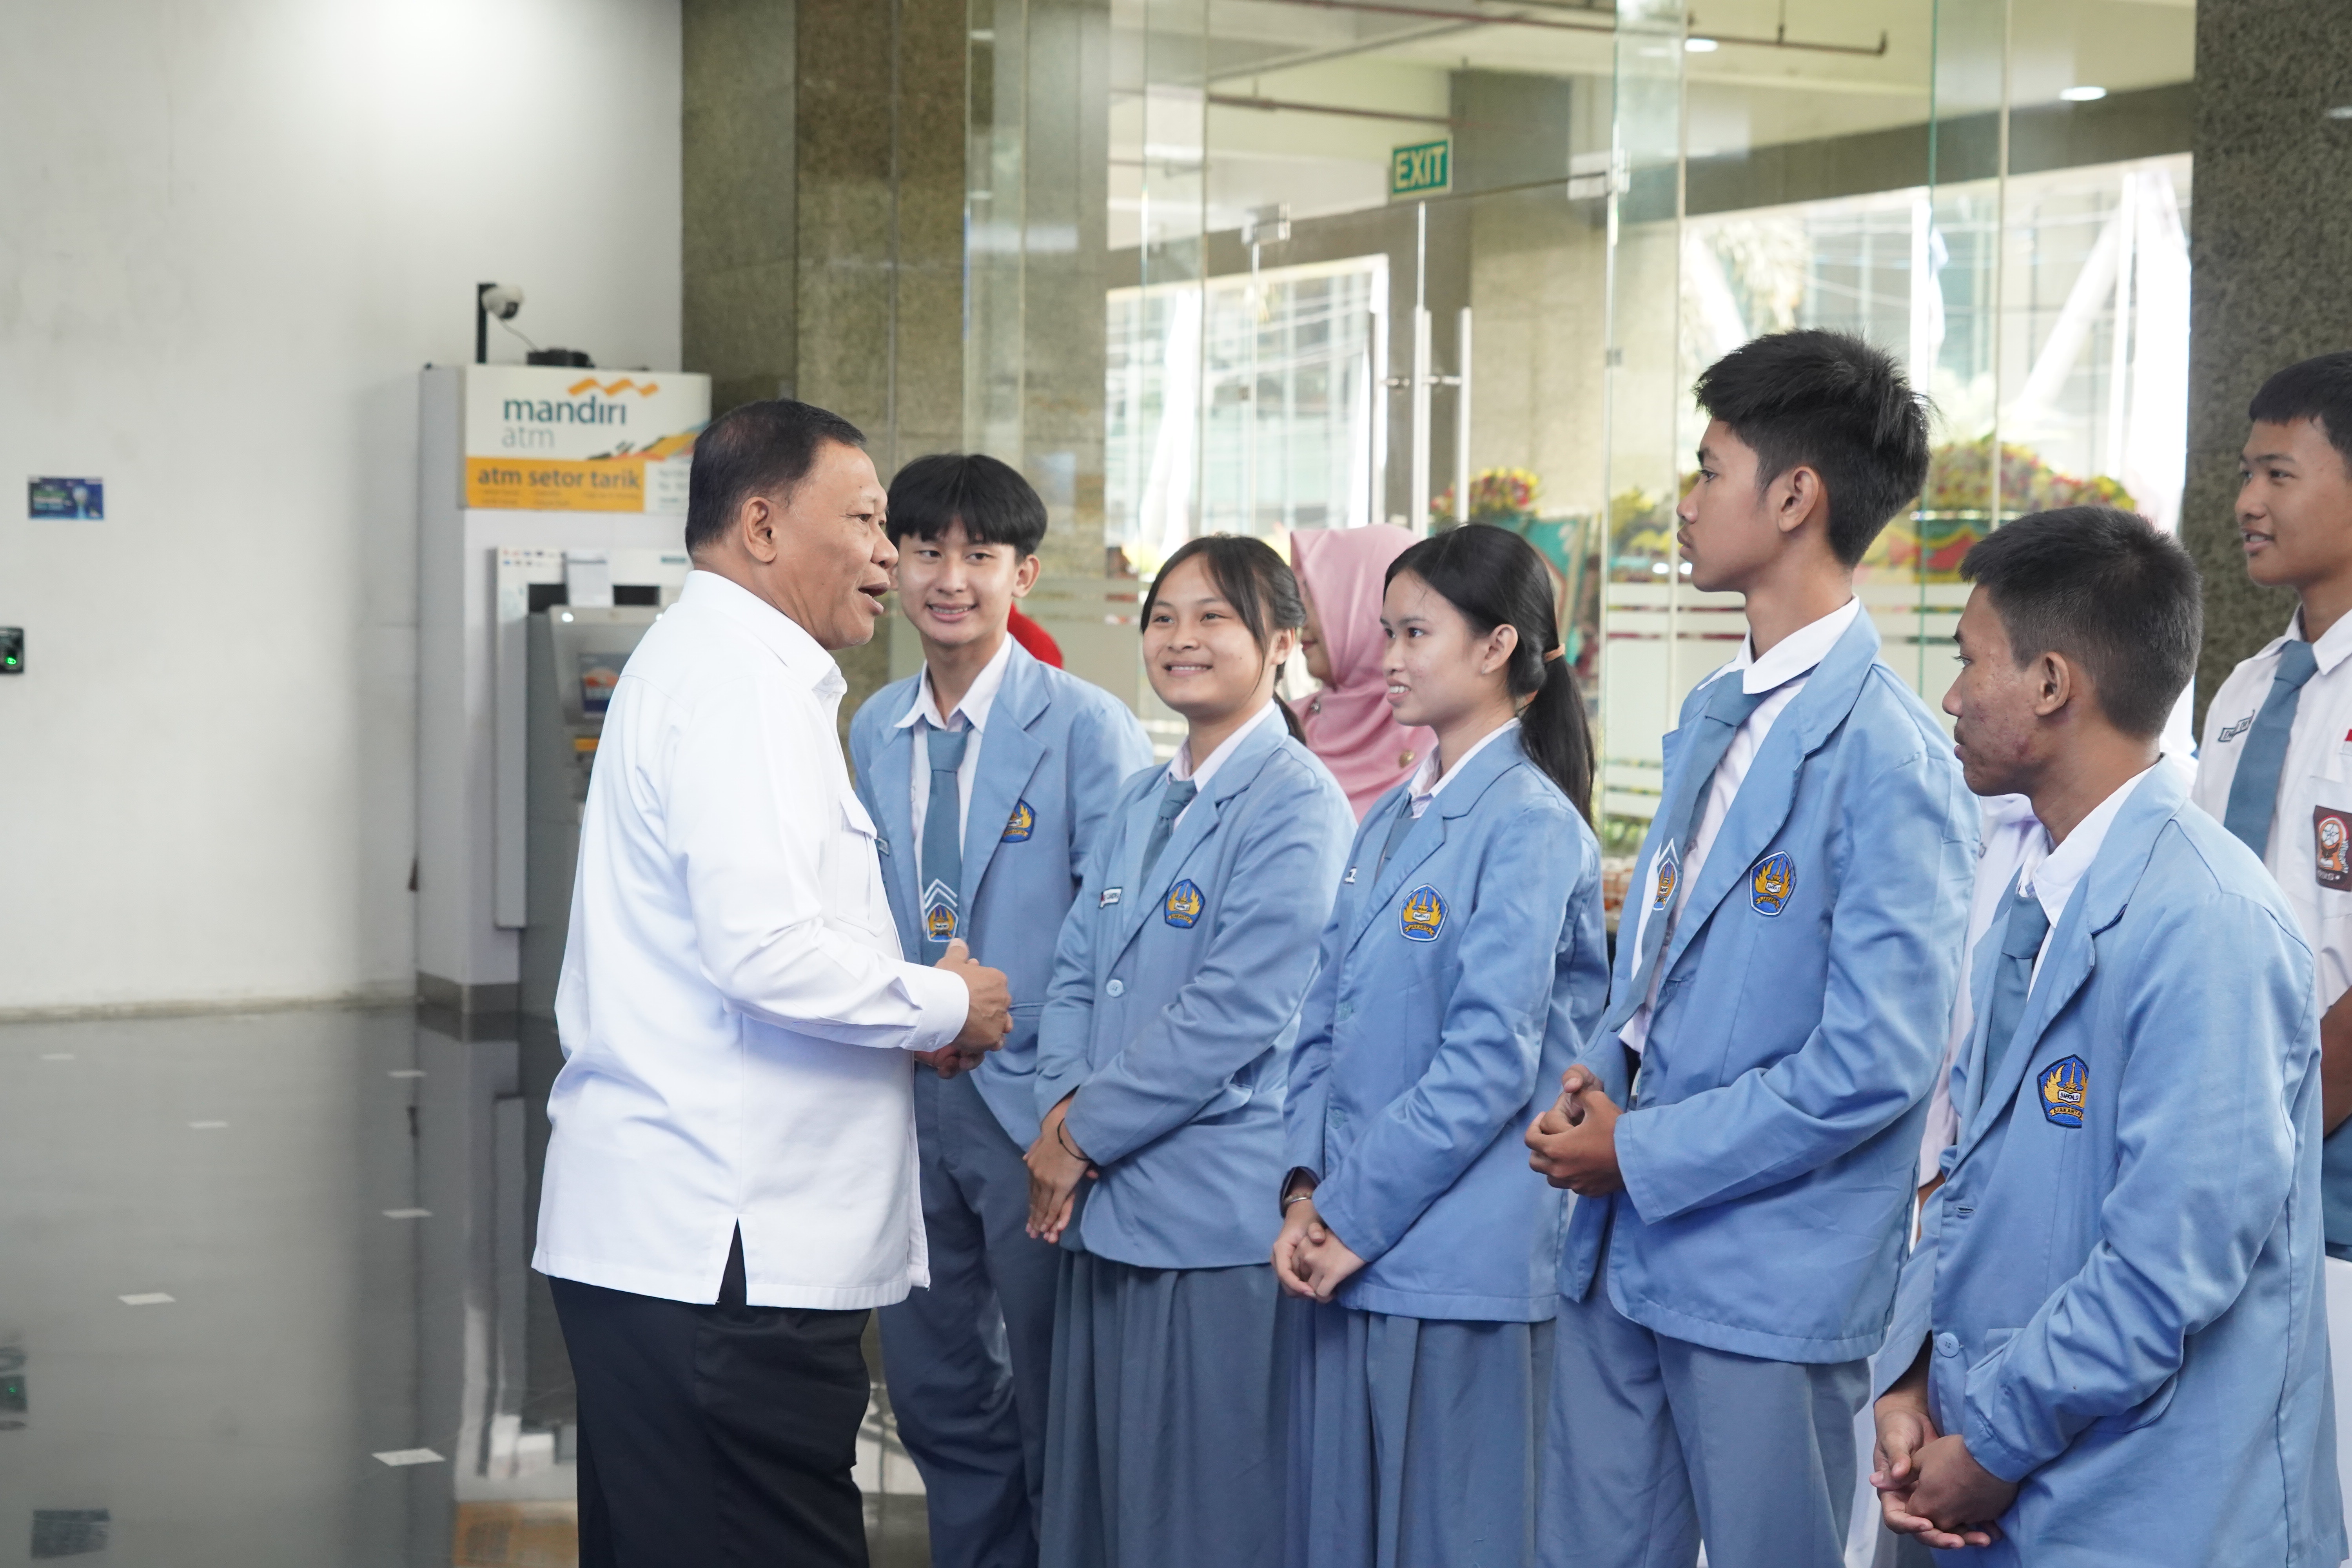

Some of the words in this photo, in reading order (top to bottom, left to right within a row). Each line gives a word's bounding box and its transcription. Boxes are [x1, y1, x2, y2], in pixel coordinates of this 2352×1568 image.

[1396, 146, 1445, 188] EXIT
[501, 426, 555, 449] atm
[477, 468, 522, 485] atm
[528, 470, 584, 487] setor
[591, 468, 640, 489] tarik
